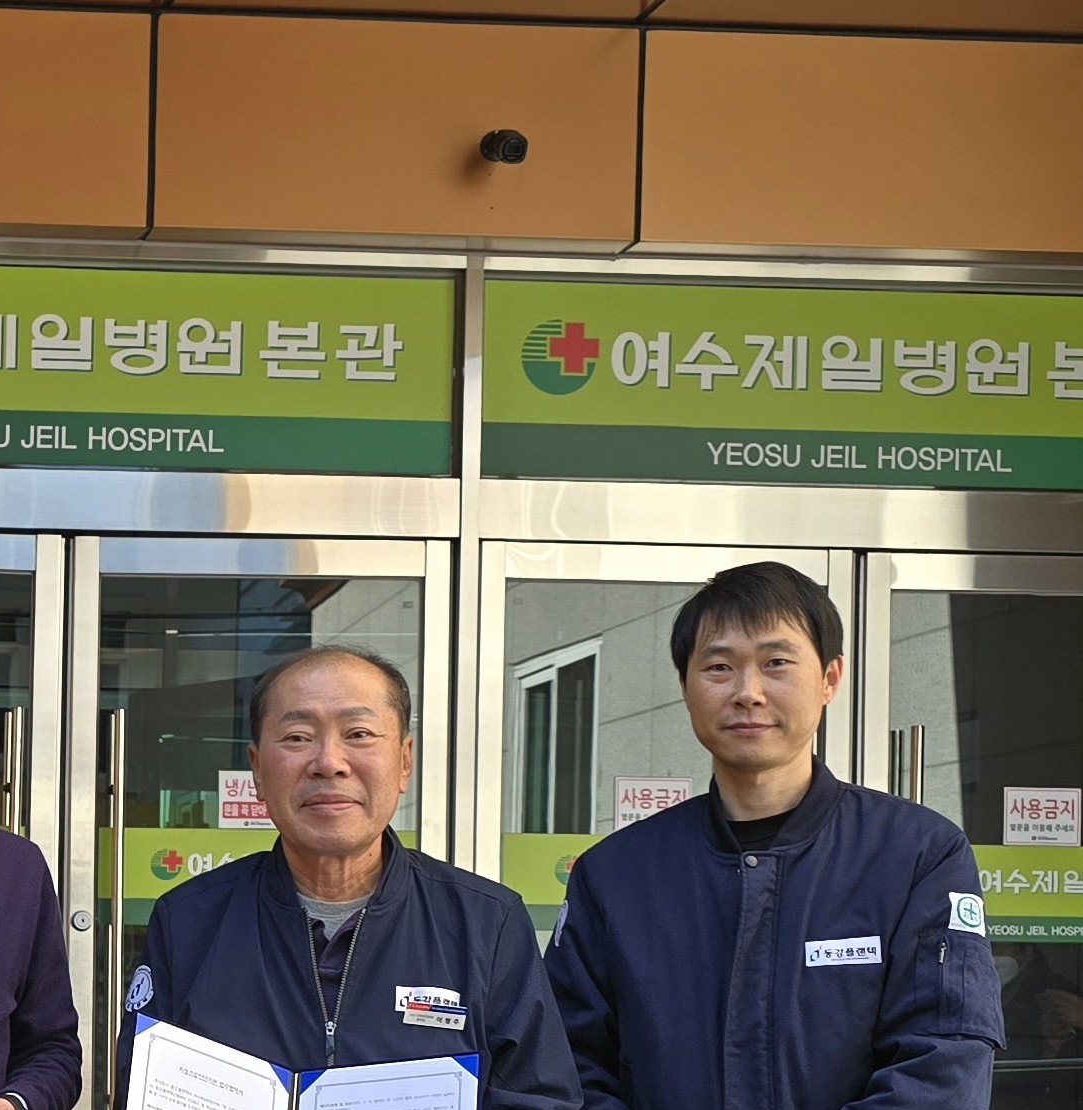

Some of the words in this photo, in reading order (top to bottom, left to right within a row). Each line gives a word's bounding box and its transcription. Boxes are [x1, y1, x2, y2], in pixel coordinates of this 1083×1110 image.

[259, 321, 404, 384] 본관
[611, 331, 1029, 395] 여수제일병원
[20, 425, 78, 450] JEIL
[88, 427, 225, 453] HOSPITAL
[706, 441, 802, 467] YEOSU
[810, 444, 867, 469] JEIL
[877, 446, 1013, 473] HOSPITAL
[621, 787, 687, 810] 사용금지
[1009, 797, 1075, 821] 사용금지
[1032, 823, 1053, 832] 이용해
[1054, 824, 1075, 833] 주세요
[988, 924, 1024, 936] YEOSU
[1026, 925, 1049, 936] JEIL
